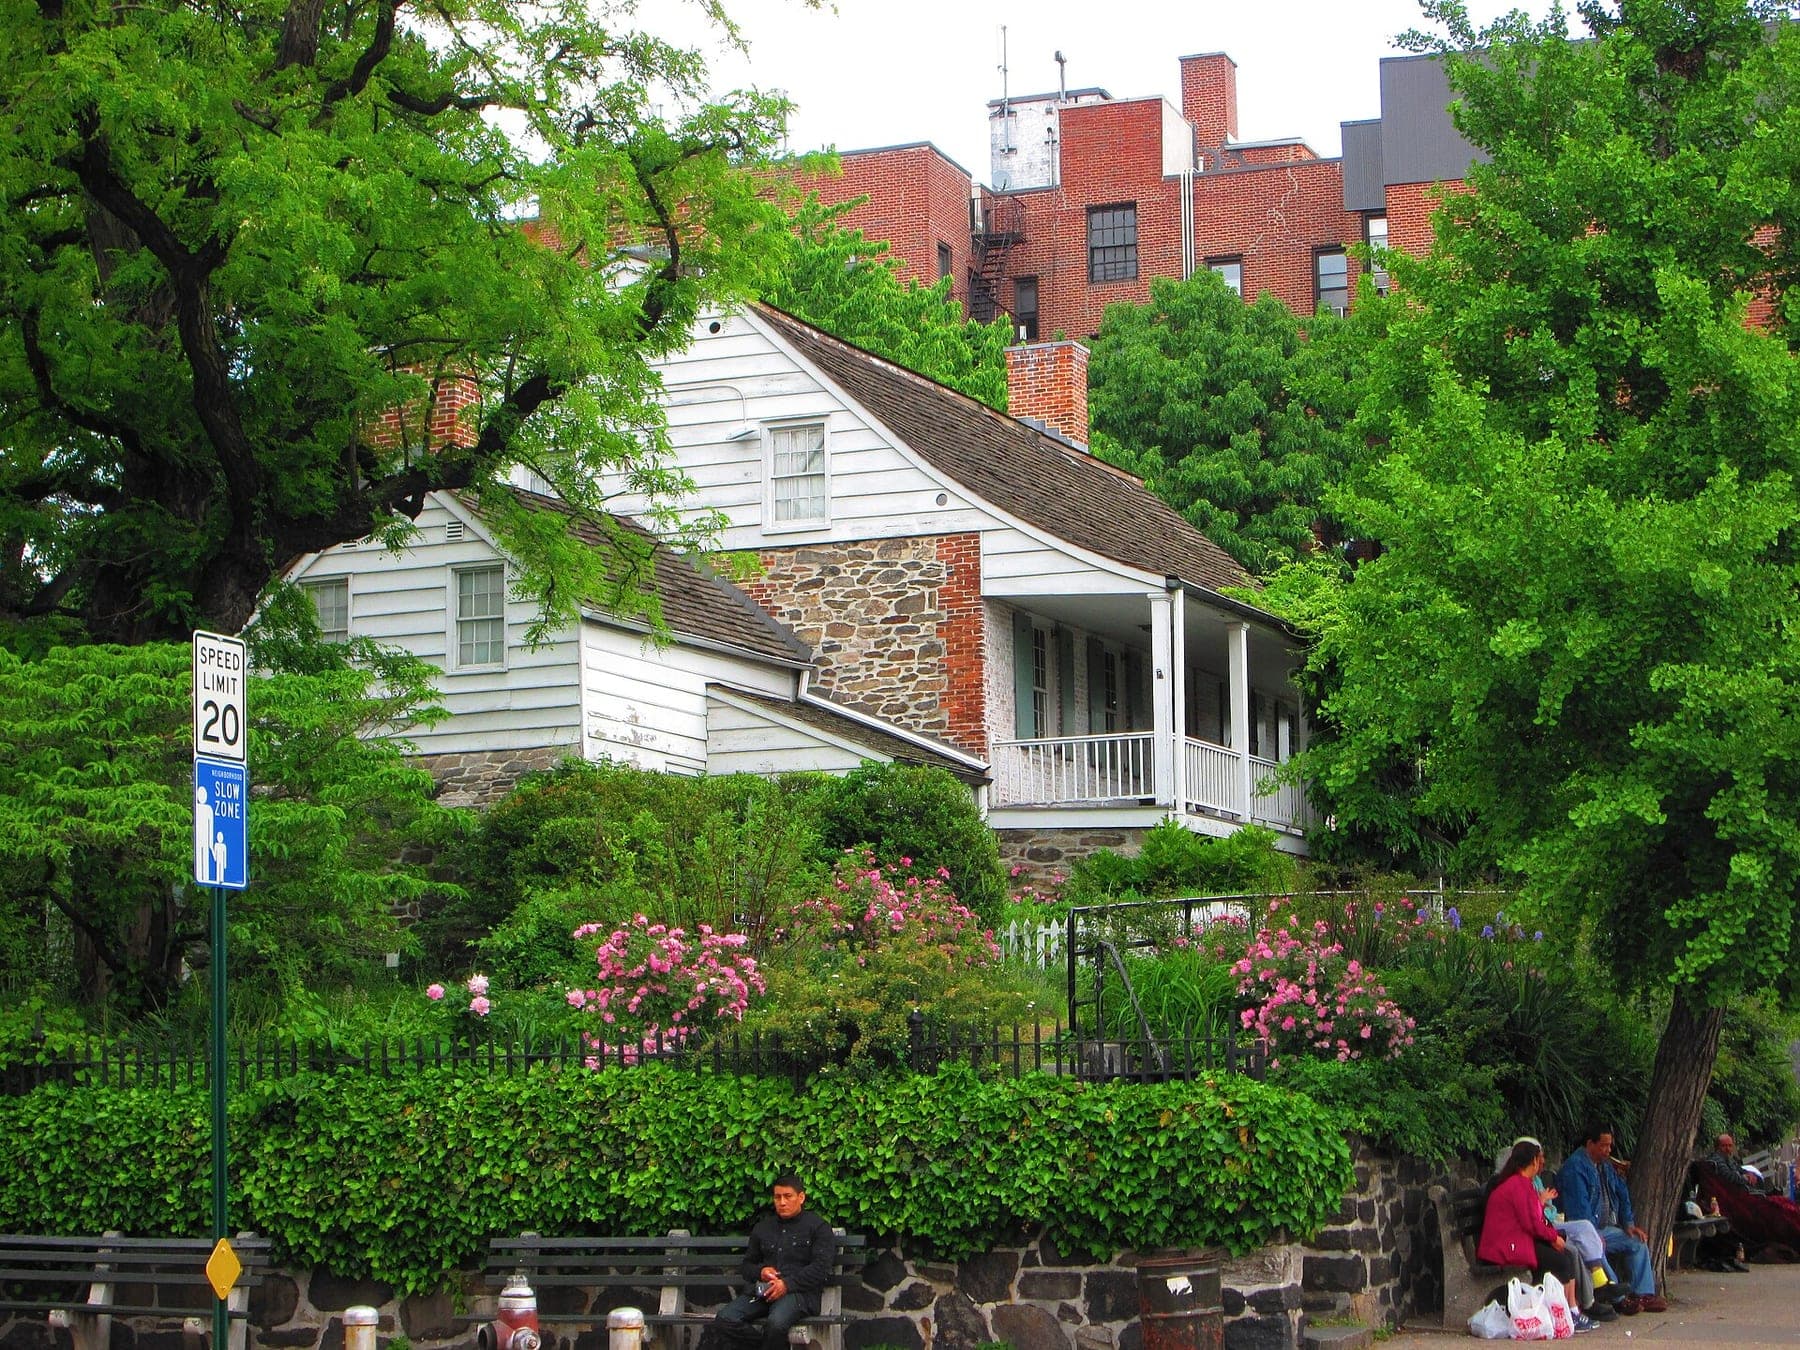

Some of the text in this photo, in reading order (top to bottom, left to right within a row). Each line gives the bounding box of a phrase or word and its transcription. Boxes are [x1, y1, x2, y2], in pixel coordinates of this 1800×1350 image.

[200, 646, 240, 671] SPEED
[203, 672, 238, 695] LIMIT
[202, 700, 240, 746] 20
[211, 769, 243, 781] NEIGHBORHOOD
[214, 780, 240, 800] SLOW
[214, 800, 241, 819] ZONE
